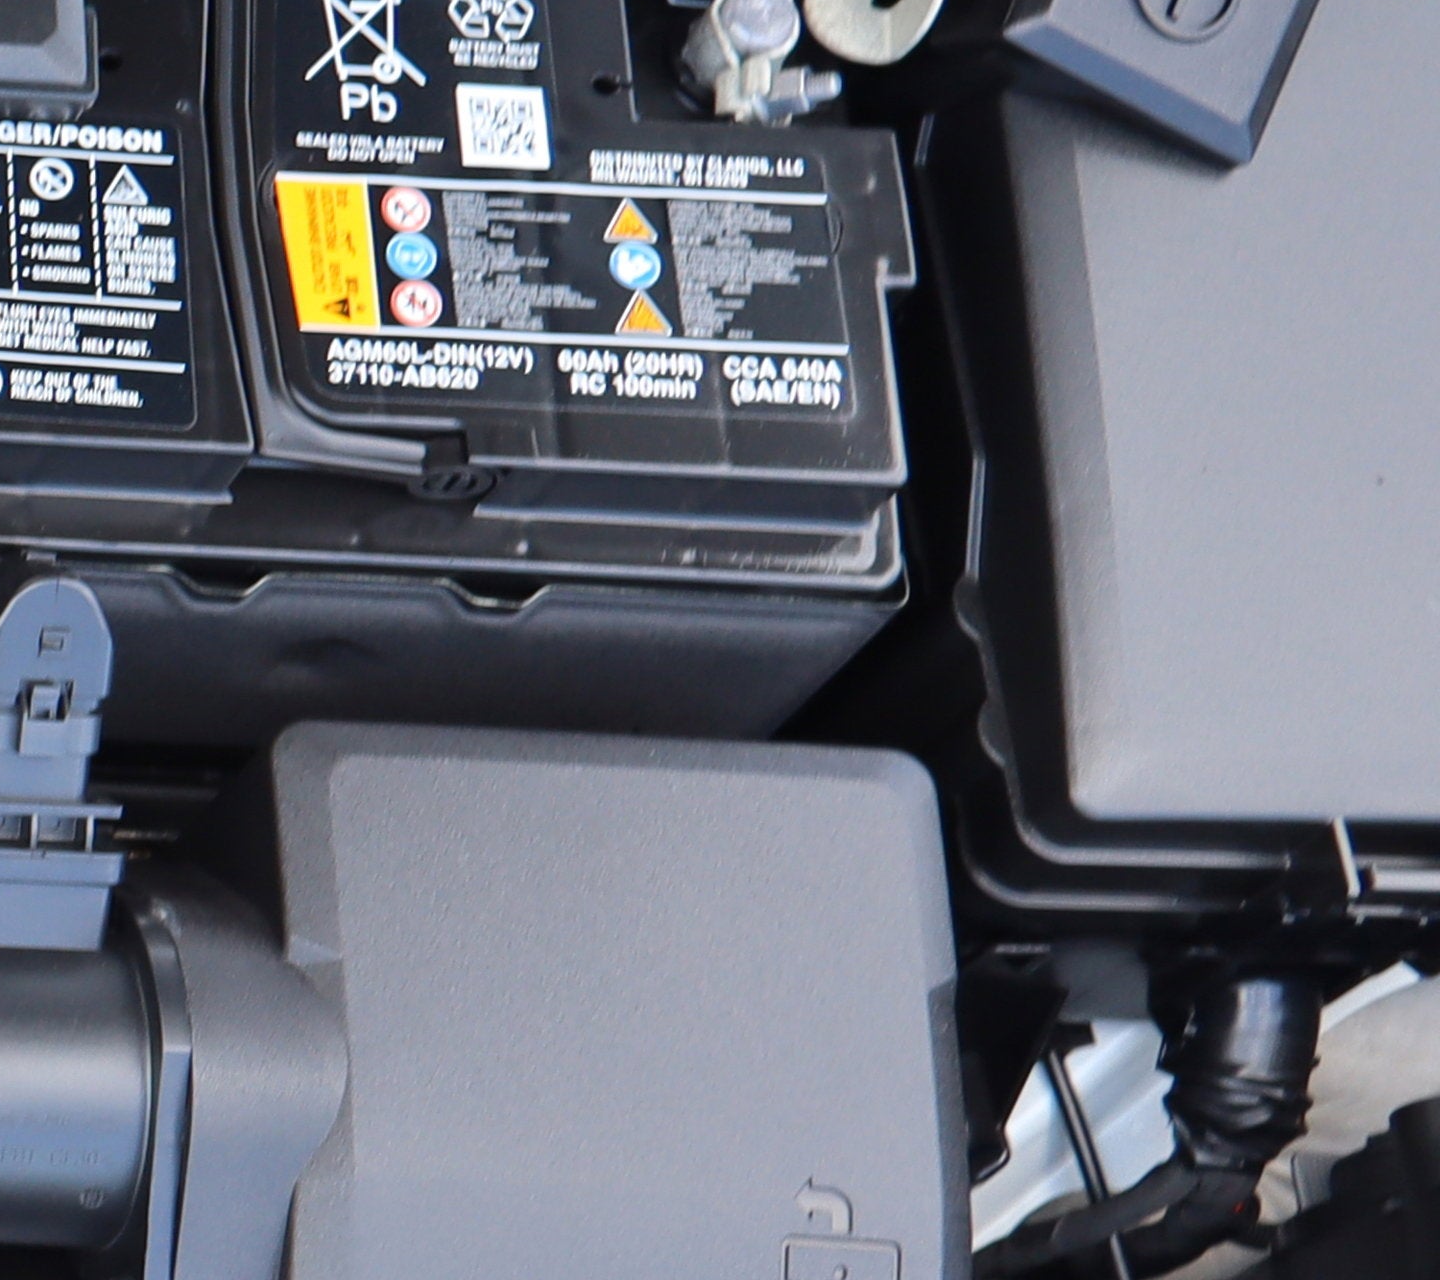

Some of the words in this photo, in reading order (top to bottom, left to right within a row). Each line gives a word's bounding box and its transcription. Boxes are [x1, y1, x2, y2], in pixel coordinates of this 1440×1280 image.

[340, 82, 397, 123] Pb
[776, 158, 804, 177] LLC
[18, 198, 40, 218] NO
[29, 221, 81, 241] SPARKS
[30, 243, 82, 263] FLAMES
[31, 263, 92, 285] SMOKING
[73, 307, 157, 329] IMMEDIATELY
[81, 337, 115, 354] HELP
[723, 355, 777, 381] CCA
[612, 373, 697, 399] 100min
